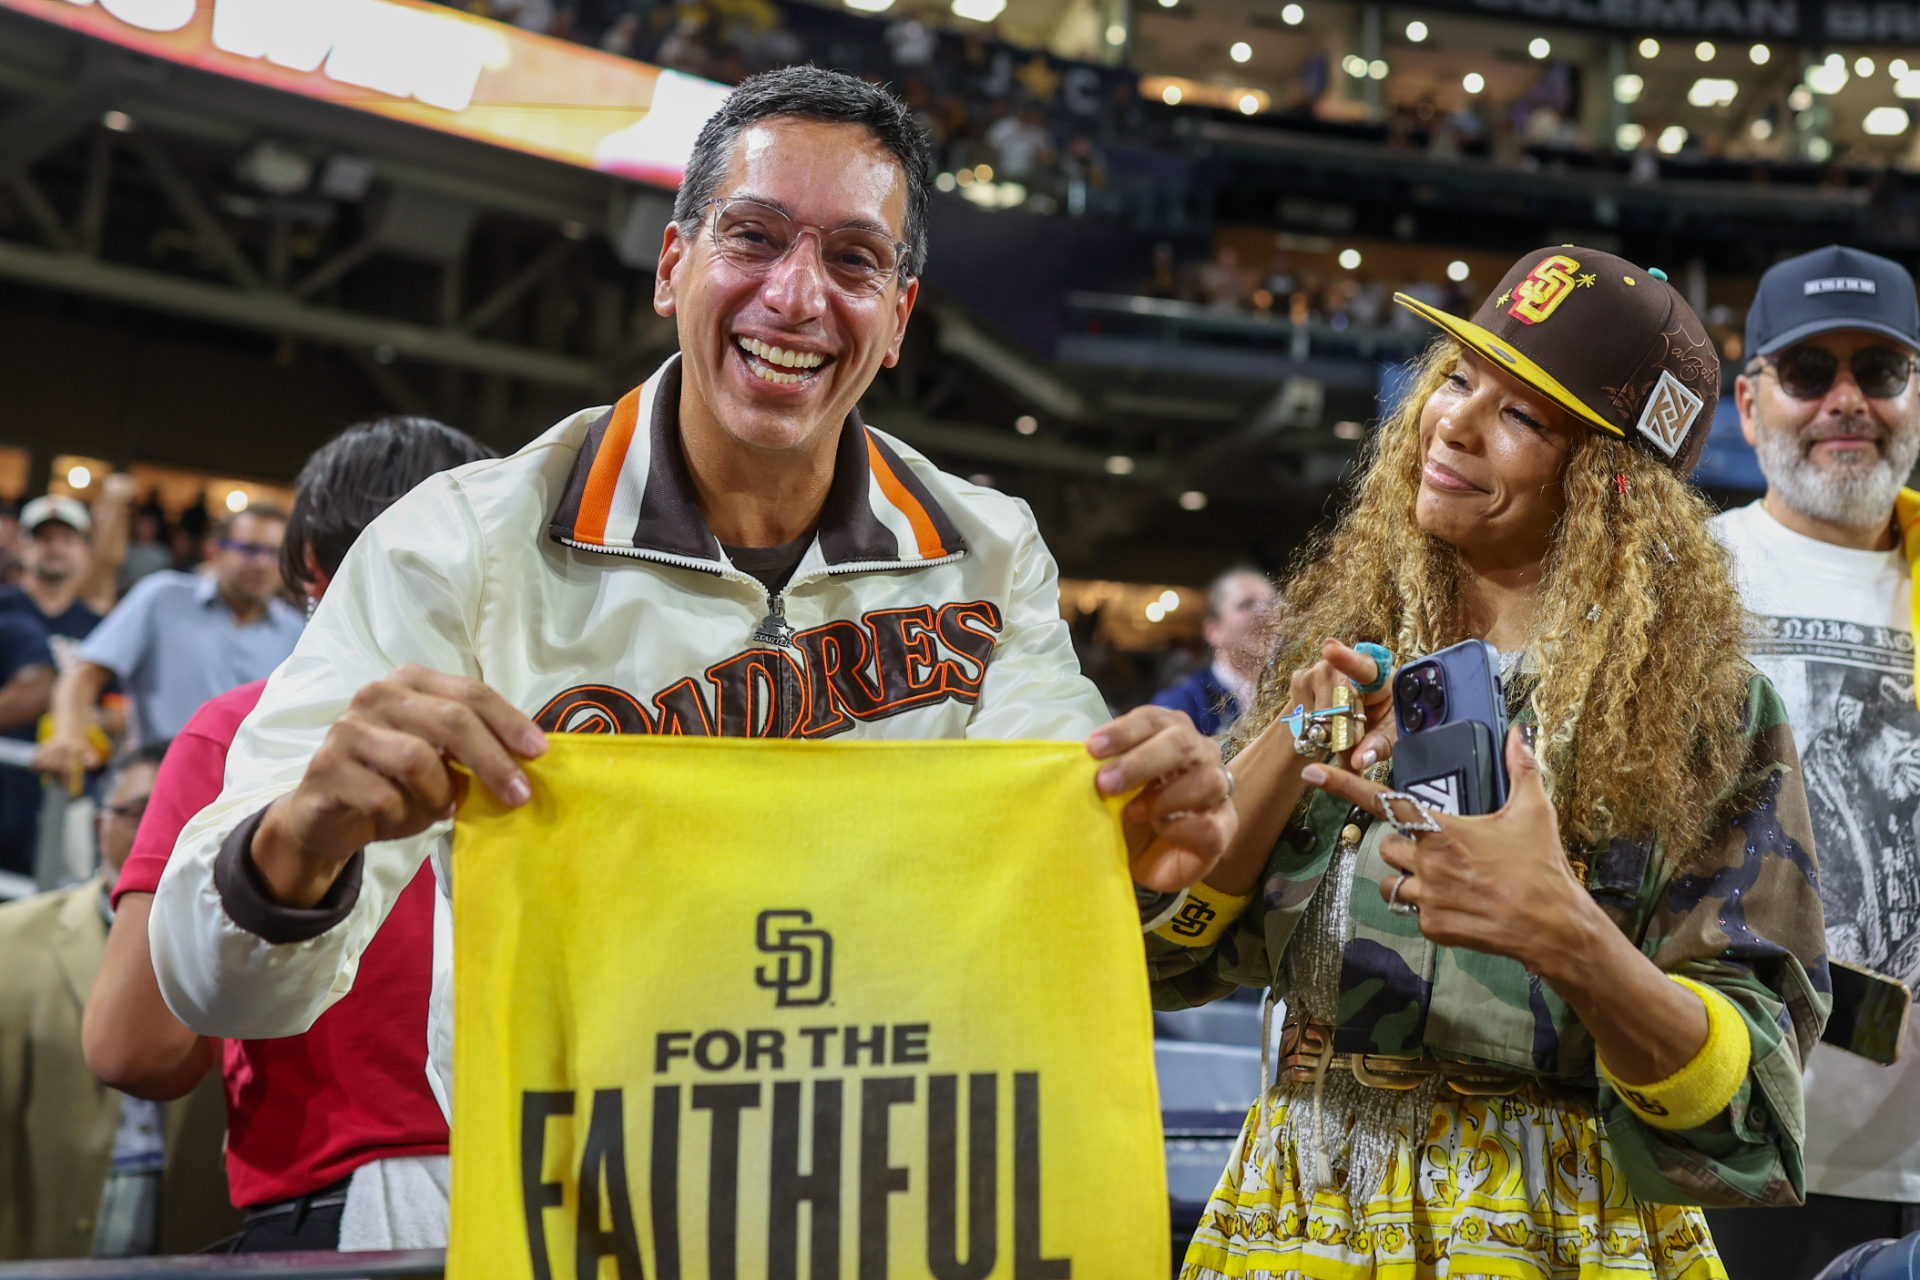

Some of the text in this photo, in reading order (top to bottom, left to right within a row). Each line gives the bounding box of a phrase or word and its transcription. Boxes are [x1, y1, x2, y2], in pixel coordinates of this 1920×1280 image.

[1473, 0, 1798, 35] LEMAN
[754, 908, 834, 1008] SD
[654, 1023, 930, 1074] FOR THE
[520, 1071, 1072, 1280] FAITHFUL
